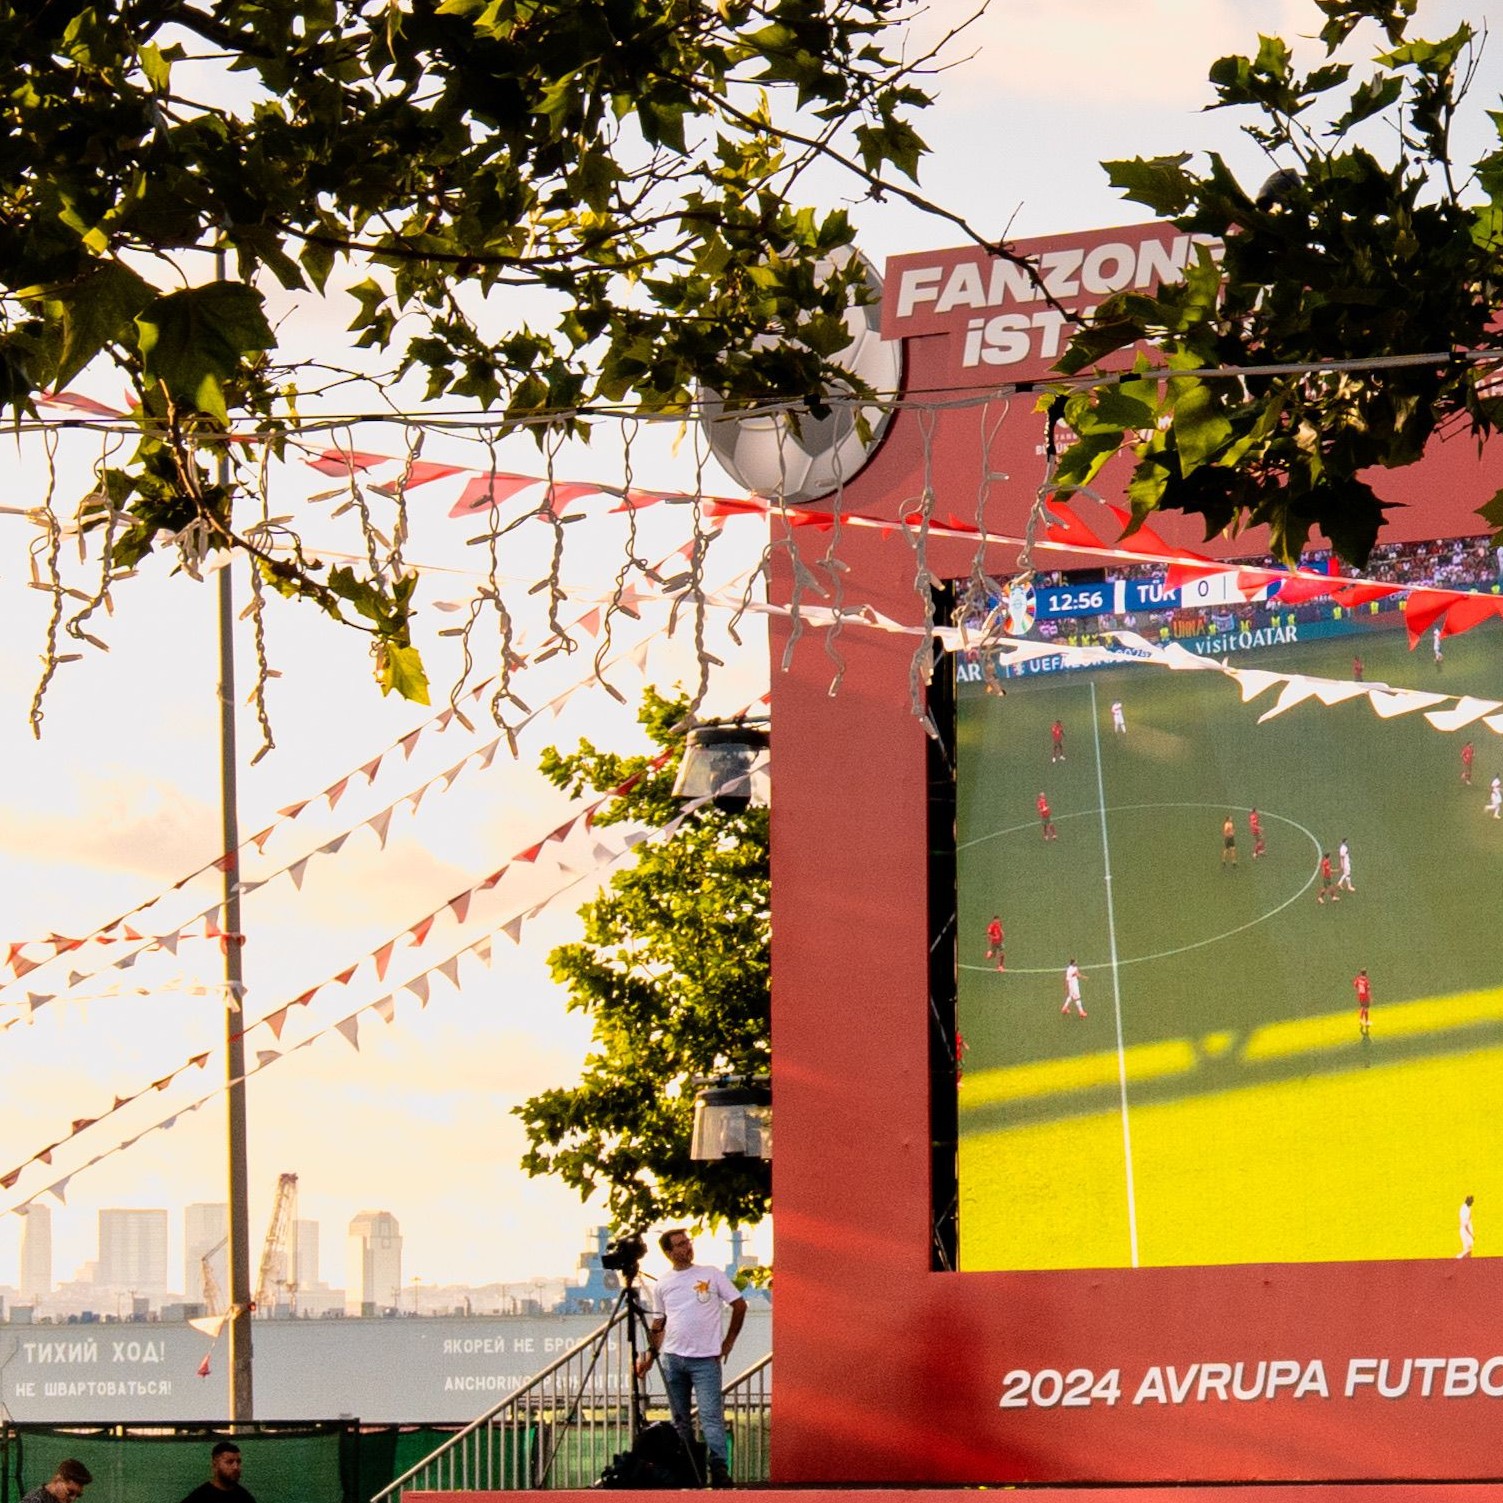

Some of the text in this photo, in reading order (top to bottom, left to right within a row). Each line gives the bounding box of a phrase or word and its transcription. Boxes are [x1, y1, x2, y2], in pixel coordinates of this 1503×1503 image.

[1049, 591, 1103, 612] 12:56
[1198, 580, 1209, 597] 0
[23, 1338, 166, 1363] ТИХИЙ ХОД!
[443, 1336, 504, 1354] ЯКОРЕЙ
[514, 1338, 534, 1352] НЕ
[16, 1380, 172, 1397] НЕ ШВАРТОВАТЬСЯ!
[999, 1368, 1122, 1407] 2024
[1133, 1360, 1329, 1405] AVRUPA
